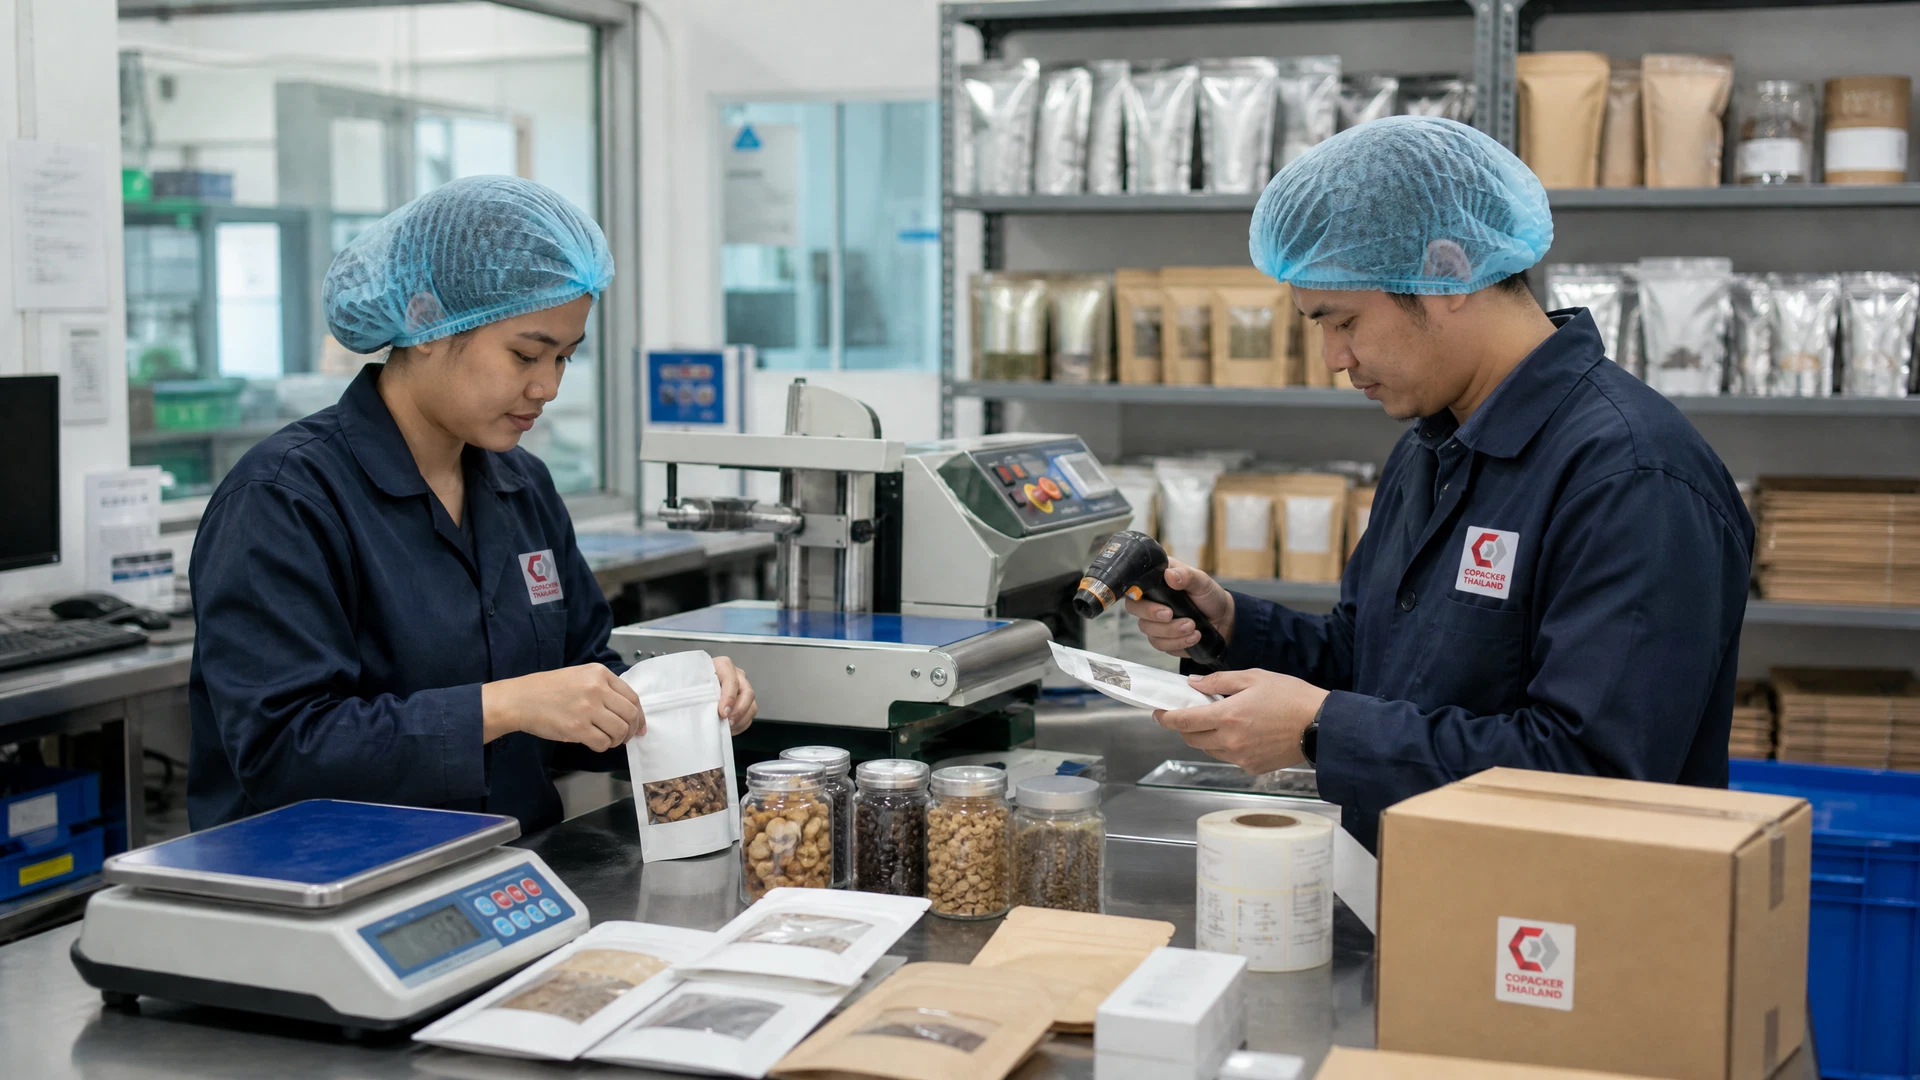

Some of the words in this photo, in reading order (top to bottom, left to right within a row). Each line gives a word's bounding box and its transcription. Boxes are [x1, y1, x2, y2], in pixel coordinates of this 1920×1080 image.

[1464, 568, 1506, 581] COPACKER
[531, 581, 559, 592] COPACKER
[1464, 576, 1504, 590] THAILAND
[532, 588, 560, 598] THAILAND
[1504, 973, 1564, 989] COPACKER
[1505, 983, 1563, 999] THAILAND
